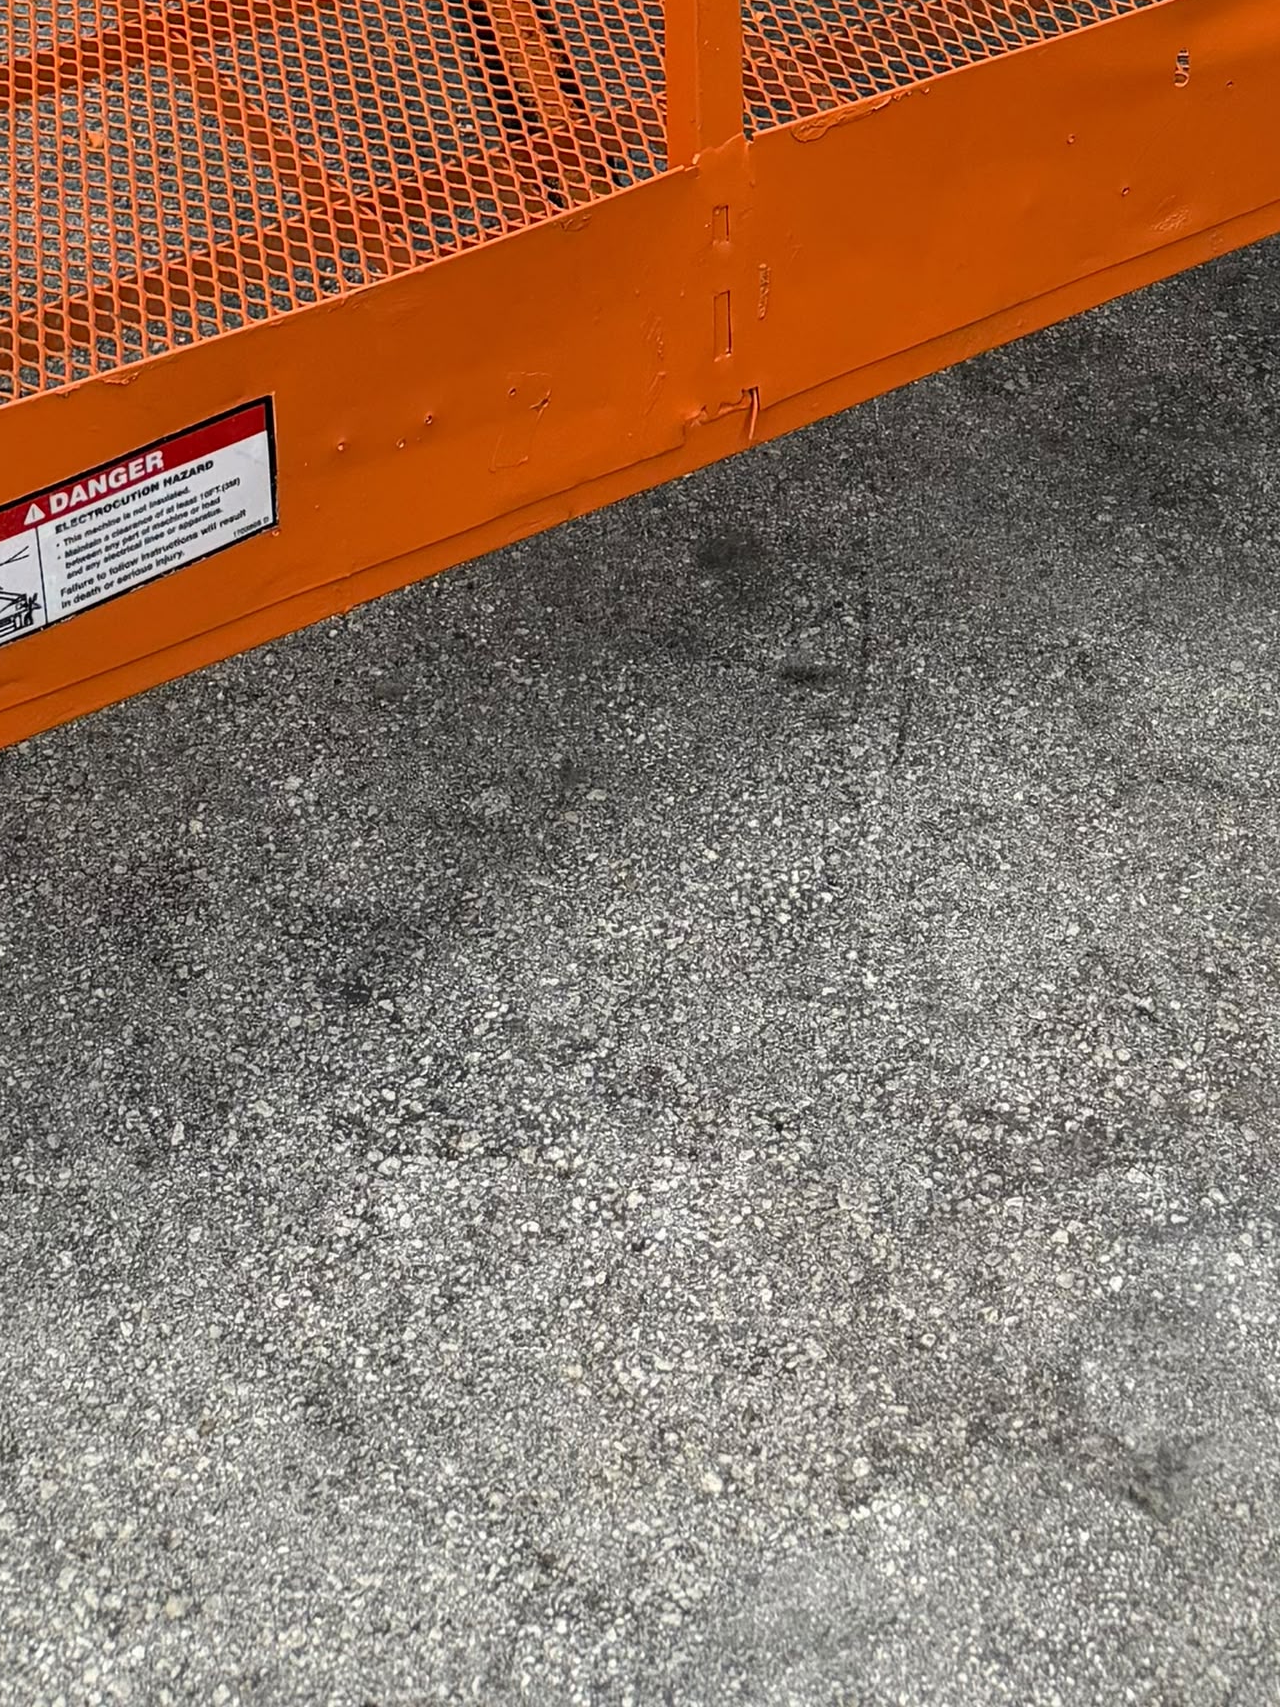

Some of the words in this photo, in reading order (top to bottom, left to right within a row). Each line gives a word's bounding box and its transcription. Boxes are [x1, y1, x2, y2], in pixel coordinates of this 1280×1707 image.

[49, 450, 165, 514] DANGER
[55, 481, 159, 534] ELECTROCUTION
[163, 458, 213, 488] HAZARD
[60, 574, 94, 598] Failure
[97, 568, 107, 582] to
[109, 555, 138, 576] follow
[141, 530, 197, 562] instructions
[200, 521, 217, 536] will
[219, 508, 246, 528] result
[64, 531, 82, 546] This
[84, 514, 120, 537] machine
[123, 510, 130, 520] is
[133, 503, 146, 516] not
[64, 535, 101, 559] Maintain
[104, 533, 109, 542] a
[112, 514, 151, 538] clearance
[154, 508, 164, 520] of
[165, 504, 174, 515] at
[176, 494, 197, 510] least
[66, 546, 102, 569] between
[104, 539, 118, 553] any
[121, 529, 138, 546] part
[141, 524, 150, 535] of
[151, 508, 188, 531] machine
[190, 505, 199, 515] or
[201, 495, 220, 510] load
[67, 565, 83, 580] and
[85, 558, 100, 572] any
[103, 539, 142, 563] electrical
[144, 529, 164, 545] lines
[167, 525, 176, 535] or
[73, 583, 101, 604] death
[104, 579, 114, 590] or
[117, 561, 152, 584] serious
